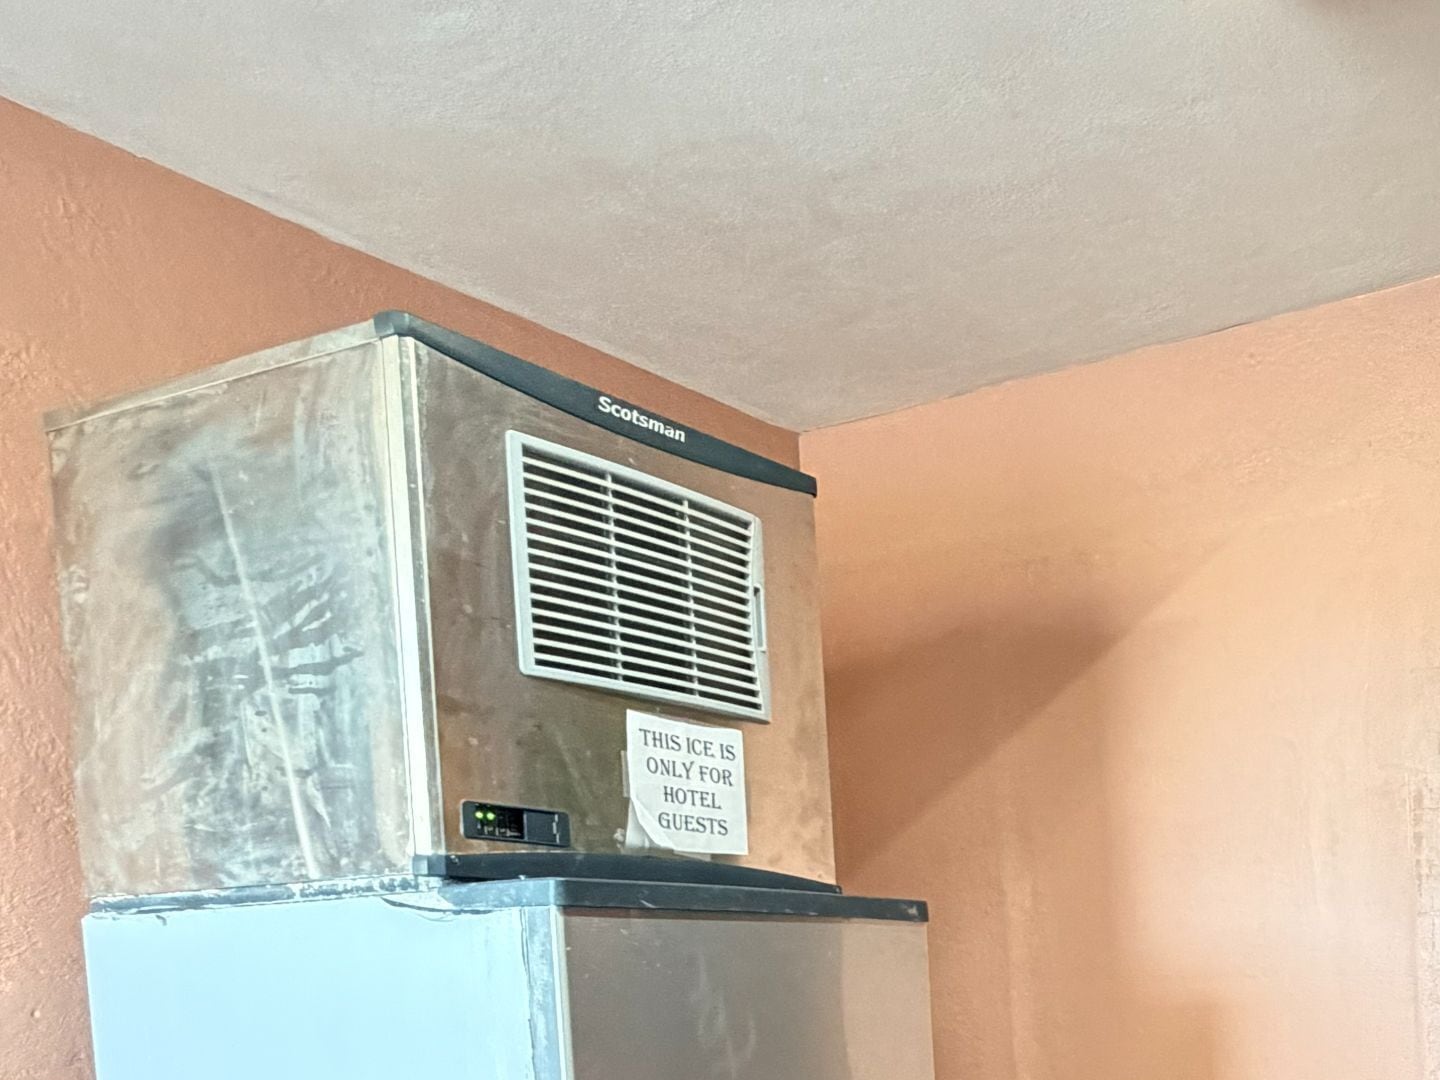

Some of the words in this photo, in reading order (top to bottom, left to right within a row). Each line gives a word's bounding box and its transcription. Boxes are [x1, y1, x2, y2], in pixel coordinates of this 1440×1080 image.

[598, 396, 686, 443] Scotsman
[639, 728, 682, 751] THIS
[686, 737, 716, 758] ICE
[720, 743, 736, 761] IS
[646, 757, 694, 780] ONLY
[699, 765, 733, 787] FOR
[663, 785, 722, 810] HOTEL
[658, 812, 728, 836] GUESTS
